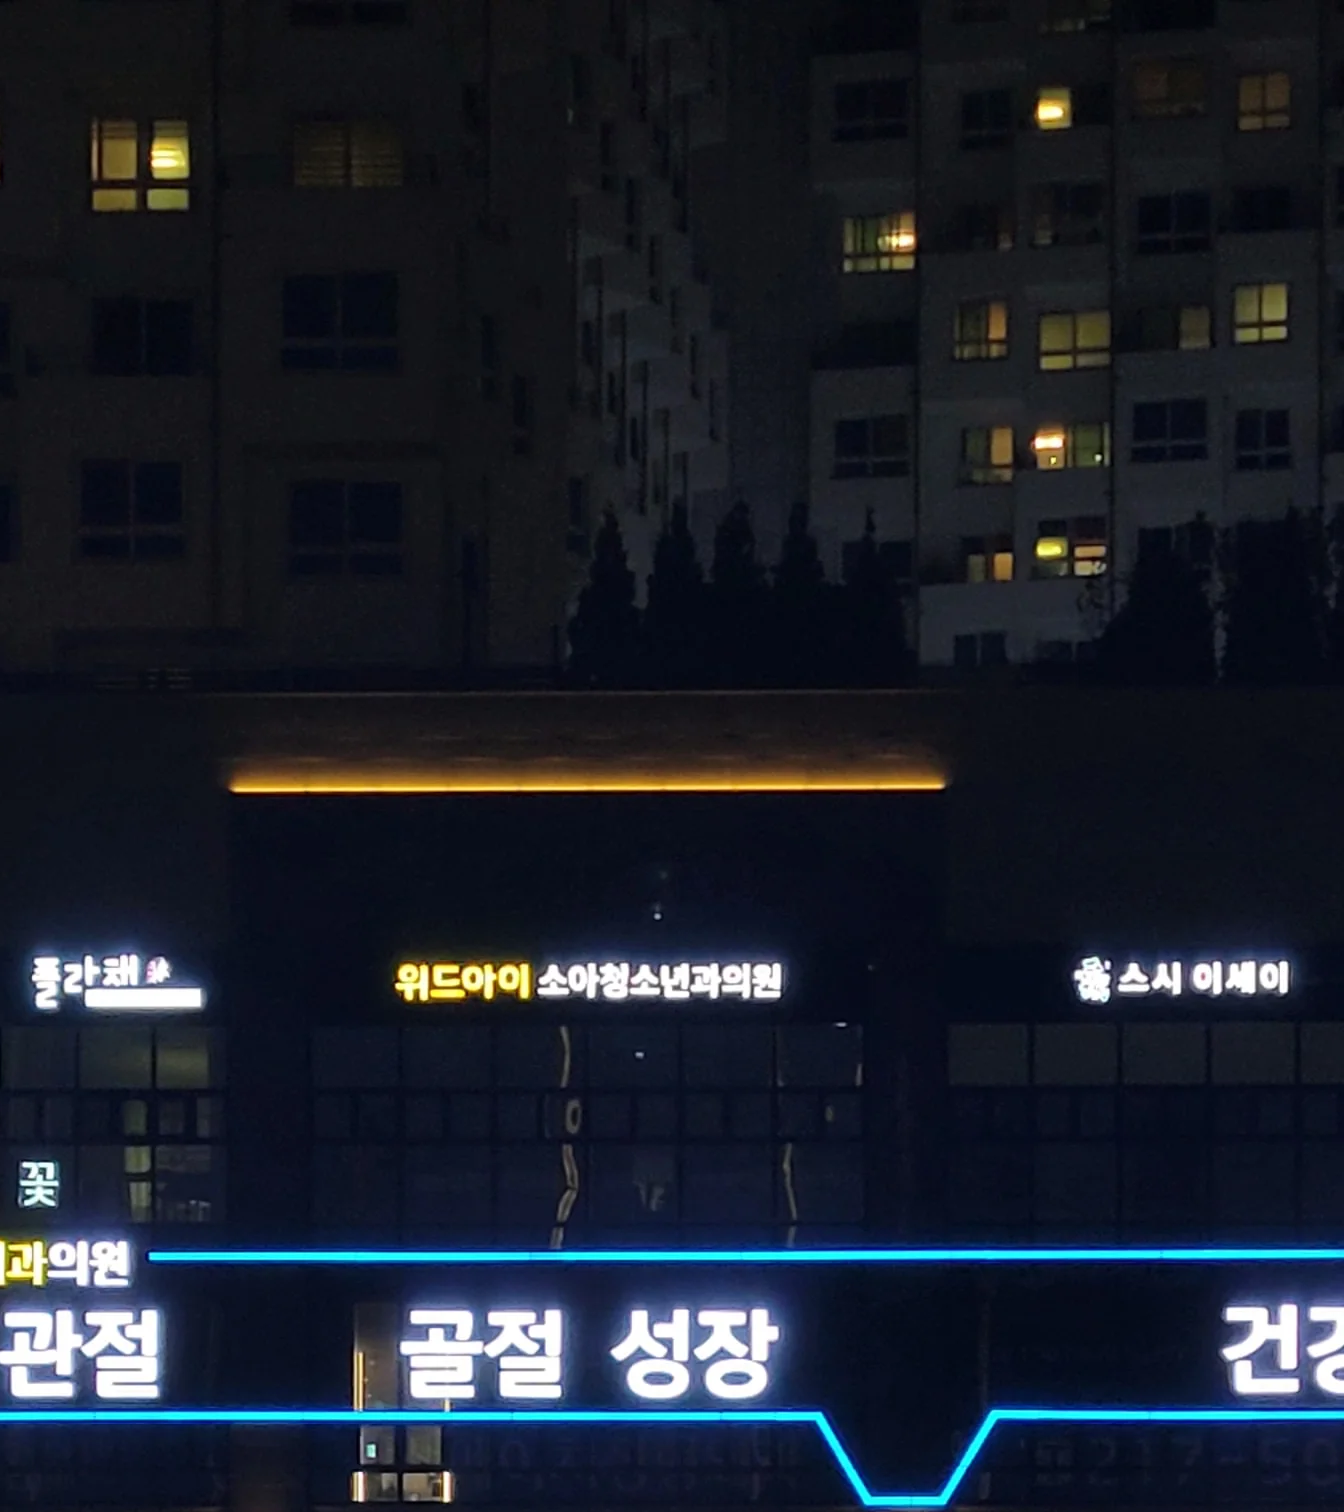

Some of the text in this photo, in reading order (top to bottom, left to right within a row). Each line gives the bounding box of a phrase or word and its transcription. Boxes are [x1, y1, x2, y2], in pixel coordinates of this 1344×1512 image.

[1192, 961, 1289, 996] 이세이
[18, 1161, 59, 1208] 꽃
[399, 1308, 780, 1400] 골절 성장
